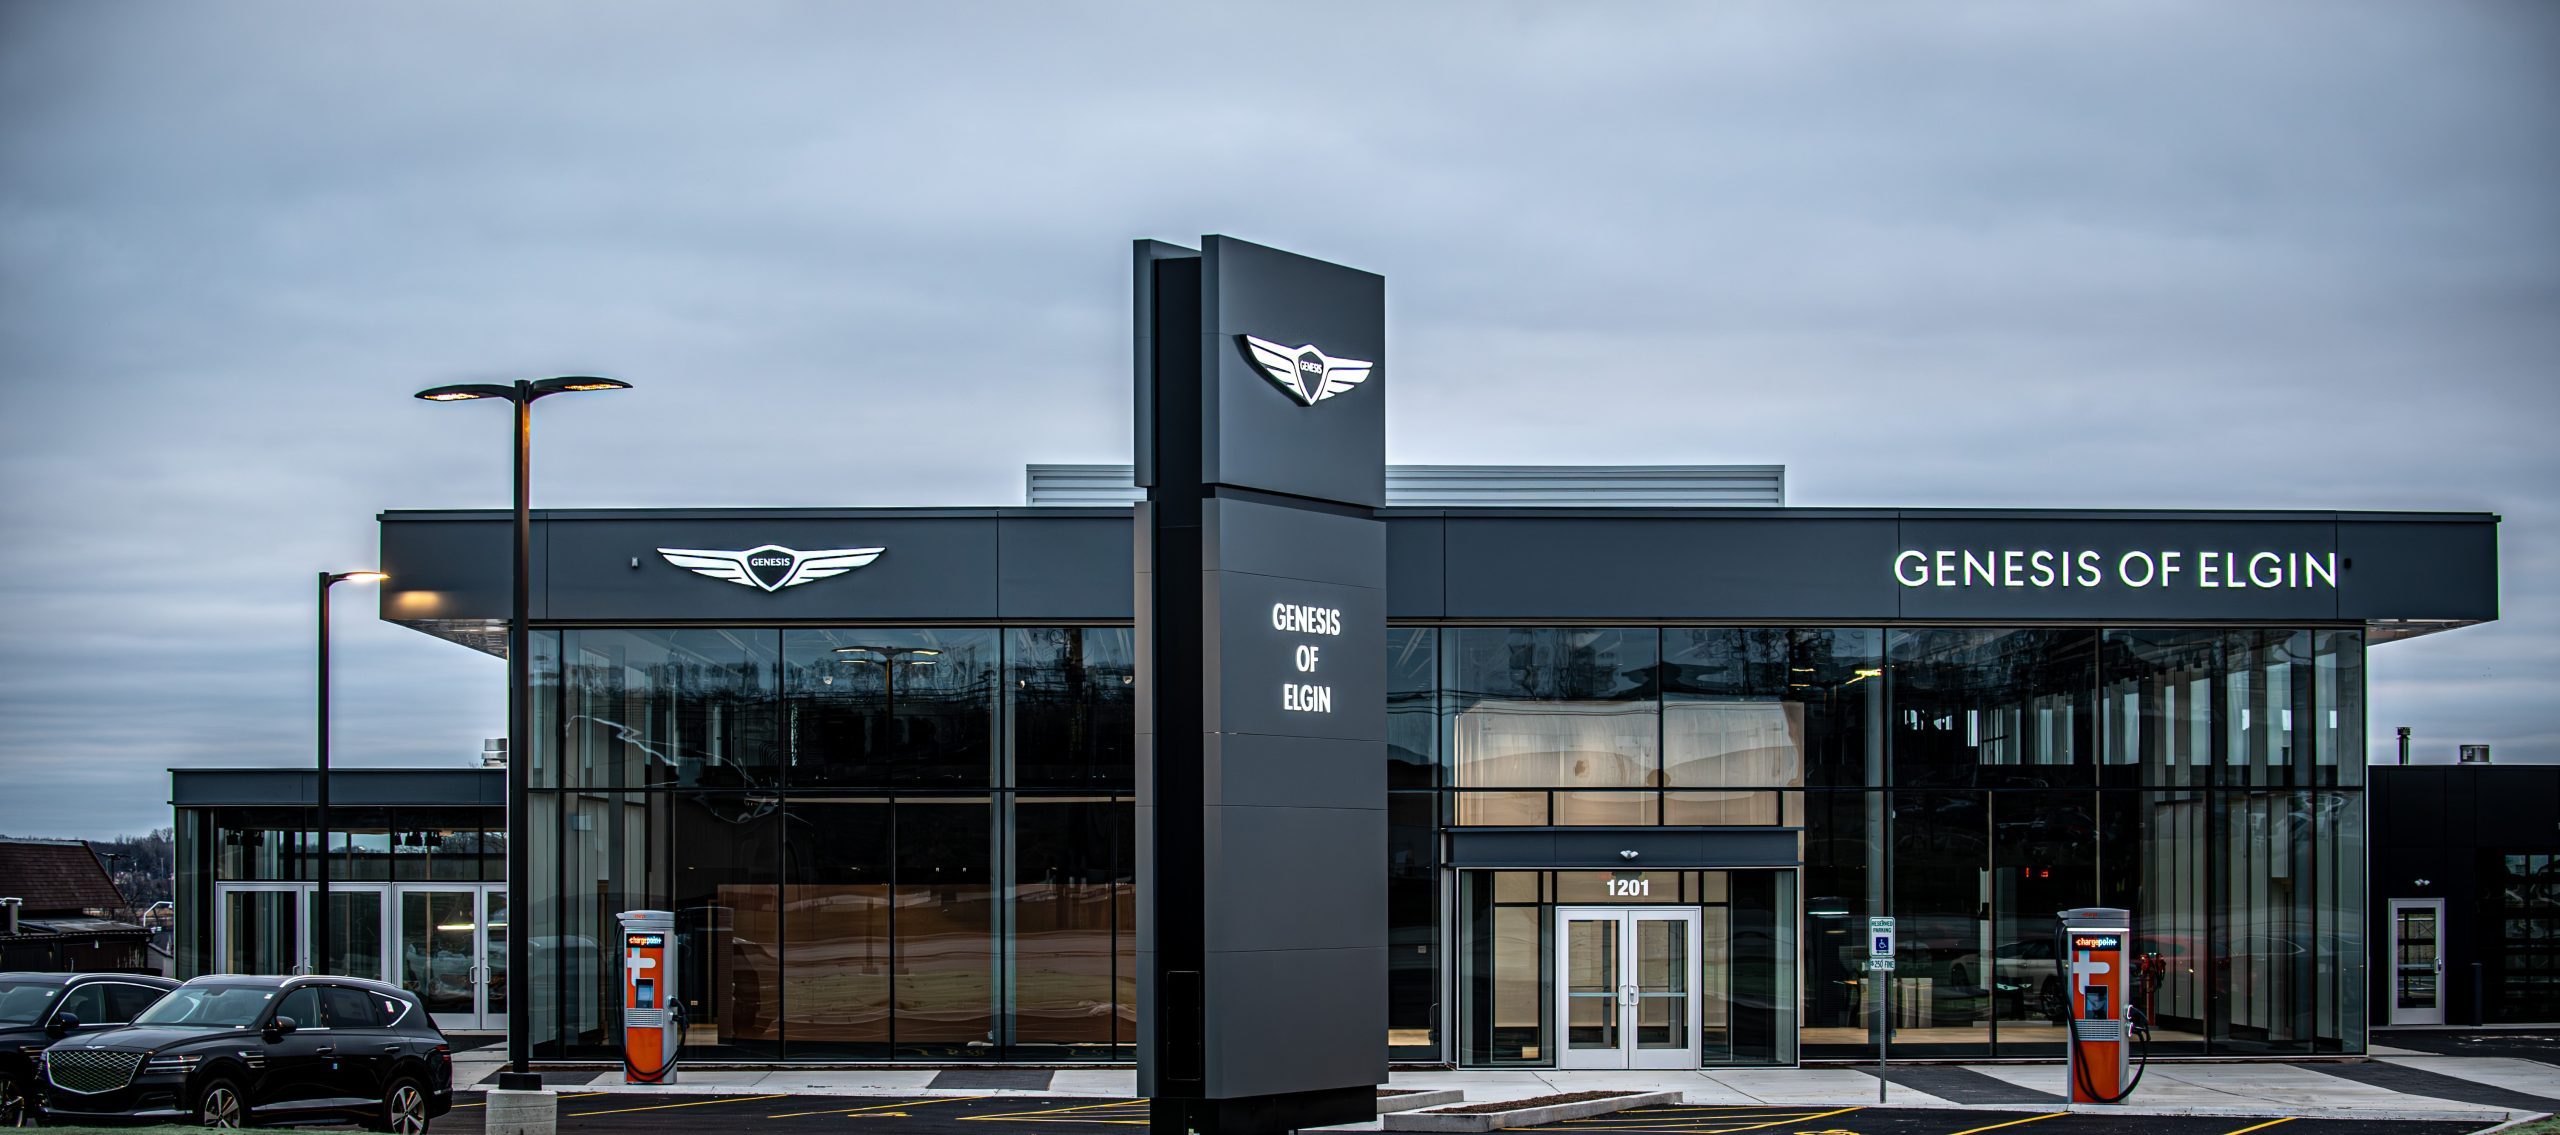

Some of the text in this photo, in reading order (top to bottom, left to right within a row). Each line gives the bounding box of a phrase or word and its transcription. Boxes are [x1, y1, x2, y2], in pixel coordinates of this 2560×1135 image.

[1300, 360, 1323, 375] GENESIS
[751, 557, 790, 567] GENESIS
[1894, 549, 2337, 588] GENESIS OF ELGIN
[1272, 603, 1341, 636] GENESIS
[1296, 645, 1319, 672] OF
[1284, 683, 1331, 713] ELGIN
[1607, 879, 1649, 896] 1201
[1884, 960, 1894, 969] FINE
